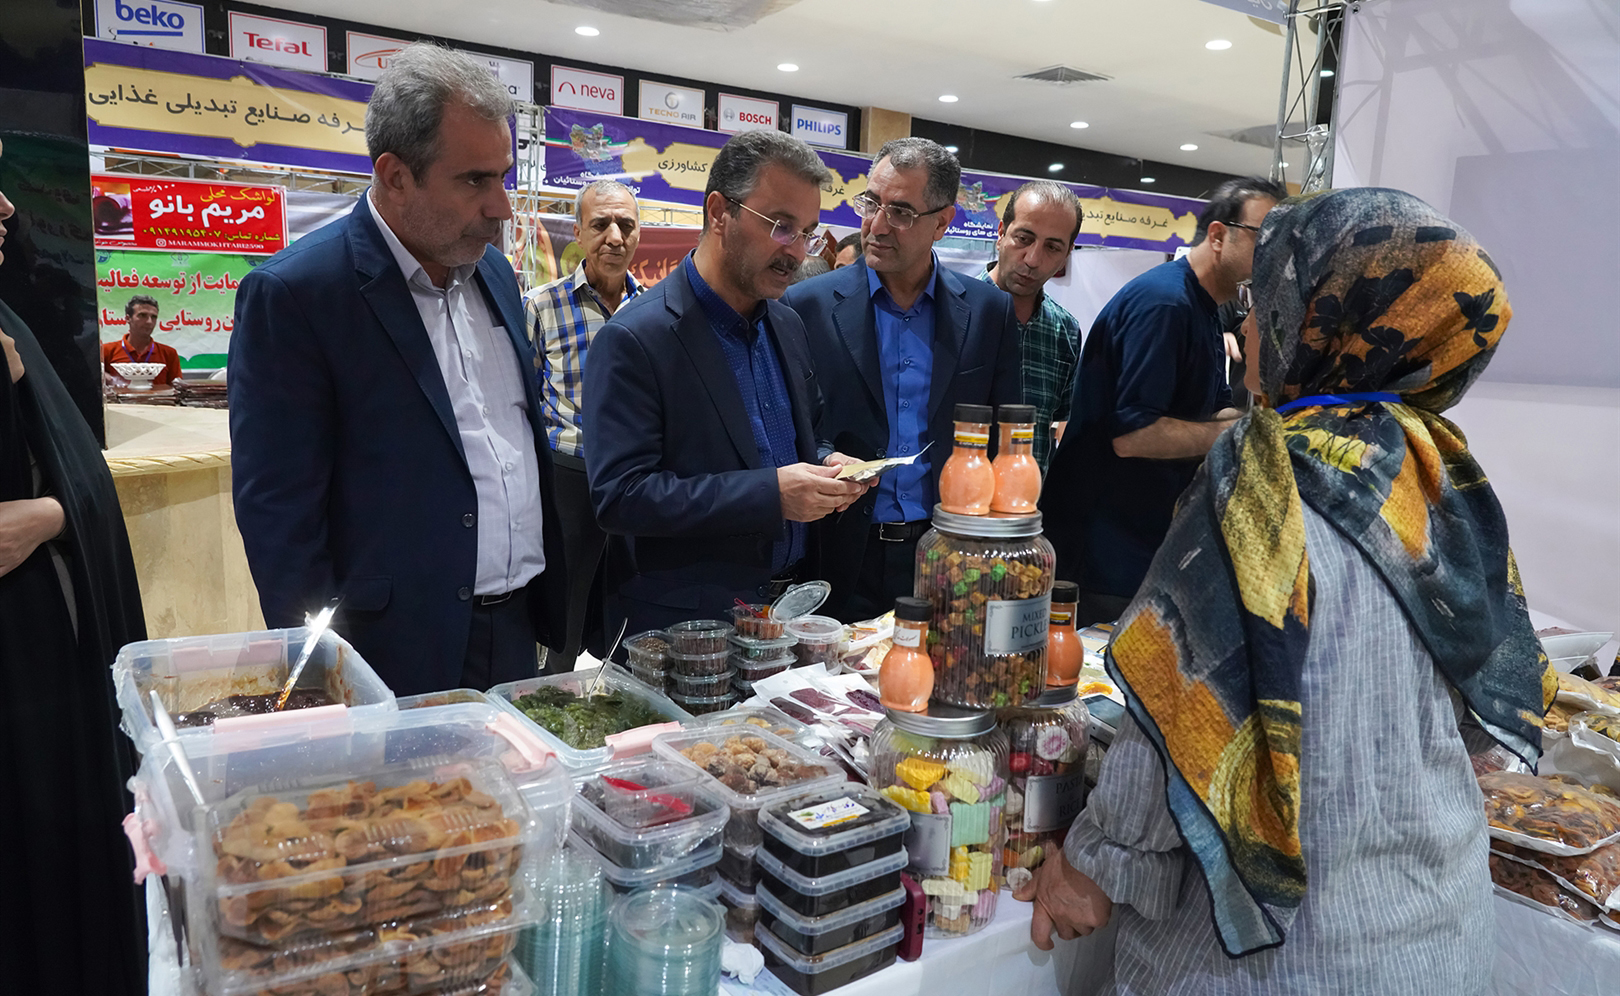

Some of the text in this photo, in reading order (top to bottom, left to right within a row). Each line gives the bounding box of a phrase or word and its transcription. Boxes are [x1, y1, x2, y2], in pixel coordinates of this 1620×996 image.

[115, 0, 185, 29] beko
[243, 31, 312, 57] Tefal
[581, 83, 615, 101] neva
[88, 84, 365, 135] رفه صنایع تبدیلی غذایی
[648, 107, 697, 121] TECNO AIR
[739, 111, 772, 125] BOSCH
[796, 118, 842, 136] PHILIPS
[657, 157, 709, 174] کشاورزی
[229, 186, 276, 206] لواشک
[149, 195, 265, 228] مریم بانو
[1103, 211, 1137, 226] صنایع
[1139, 215, 1168, 229] غرفه
[255, 231, 281, 242] شماره
[142, 272, 186, 295] توسعه
[188, 271, 202, 295] از
[203, 271, 240, 295] مایت
[159, 309, 221, 332] روستایی
[1022, 607, 1047, 623] MIXED
